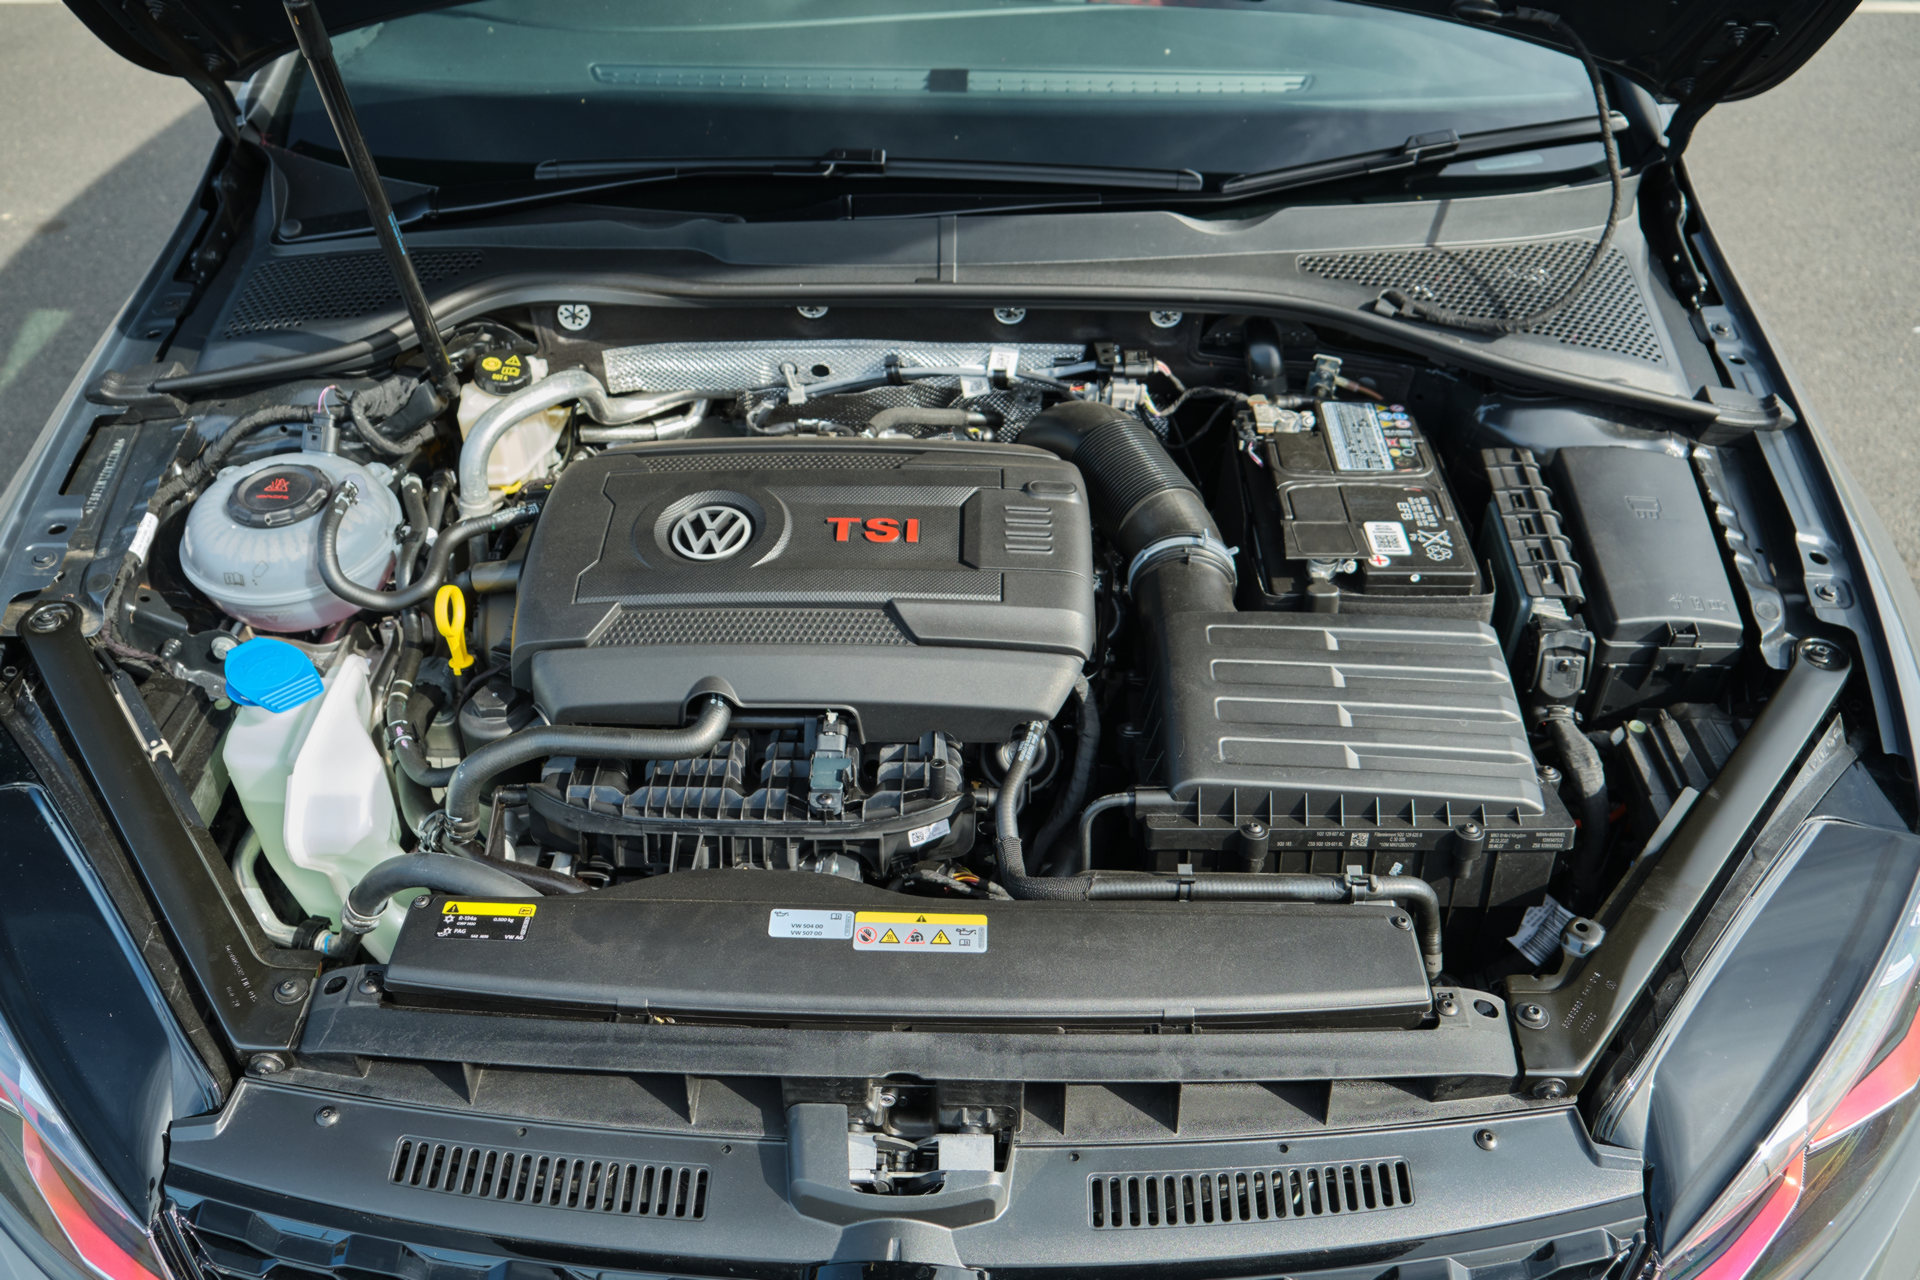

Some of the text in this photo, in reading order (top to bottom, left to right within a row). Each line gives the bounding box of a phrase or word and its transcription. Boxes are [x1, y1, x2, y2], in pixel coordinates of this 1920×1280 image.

[491, 373, 503, 381] DOT
[1396, 502, 1414, 520] EFB
[825, 517, 919, 543] TSI
